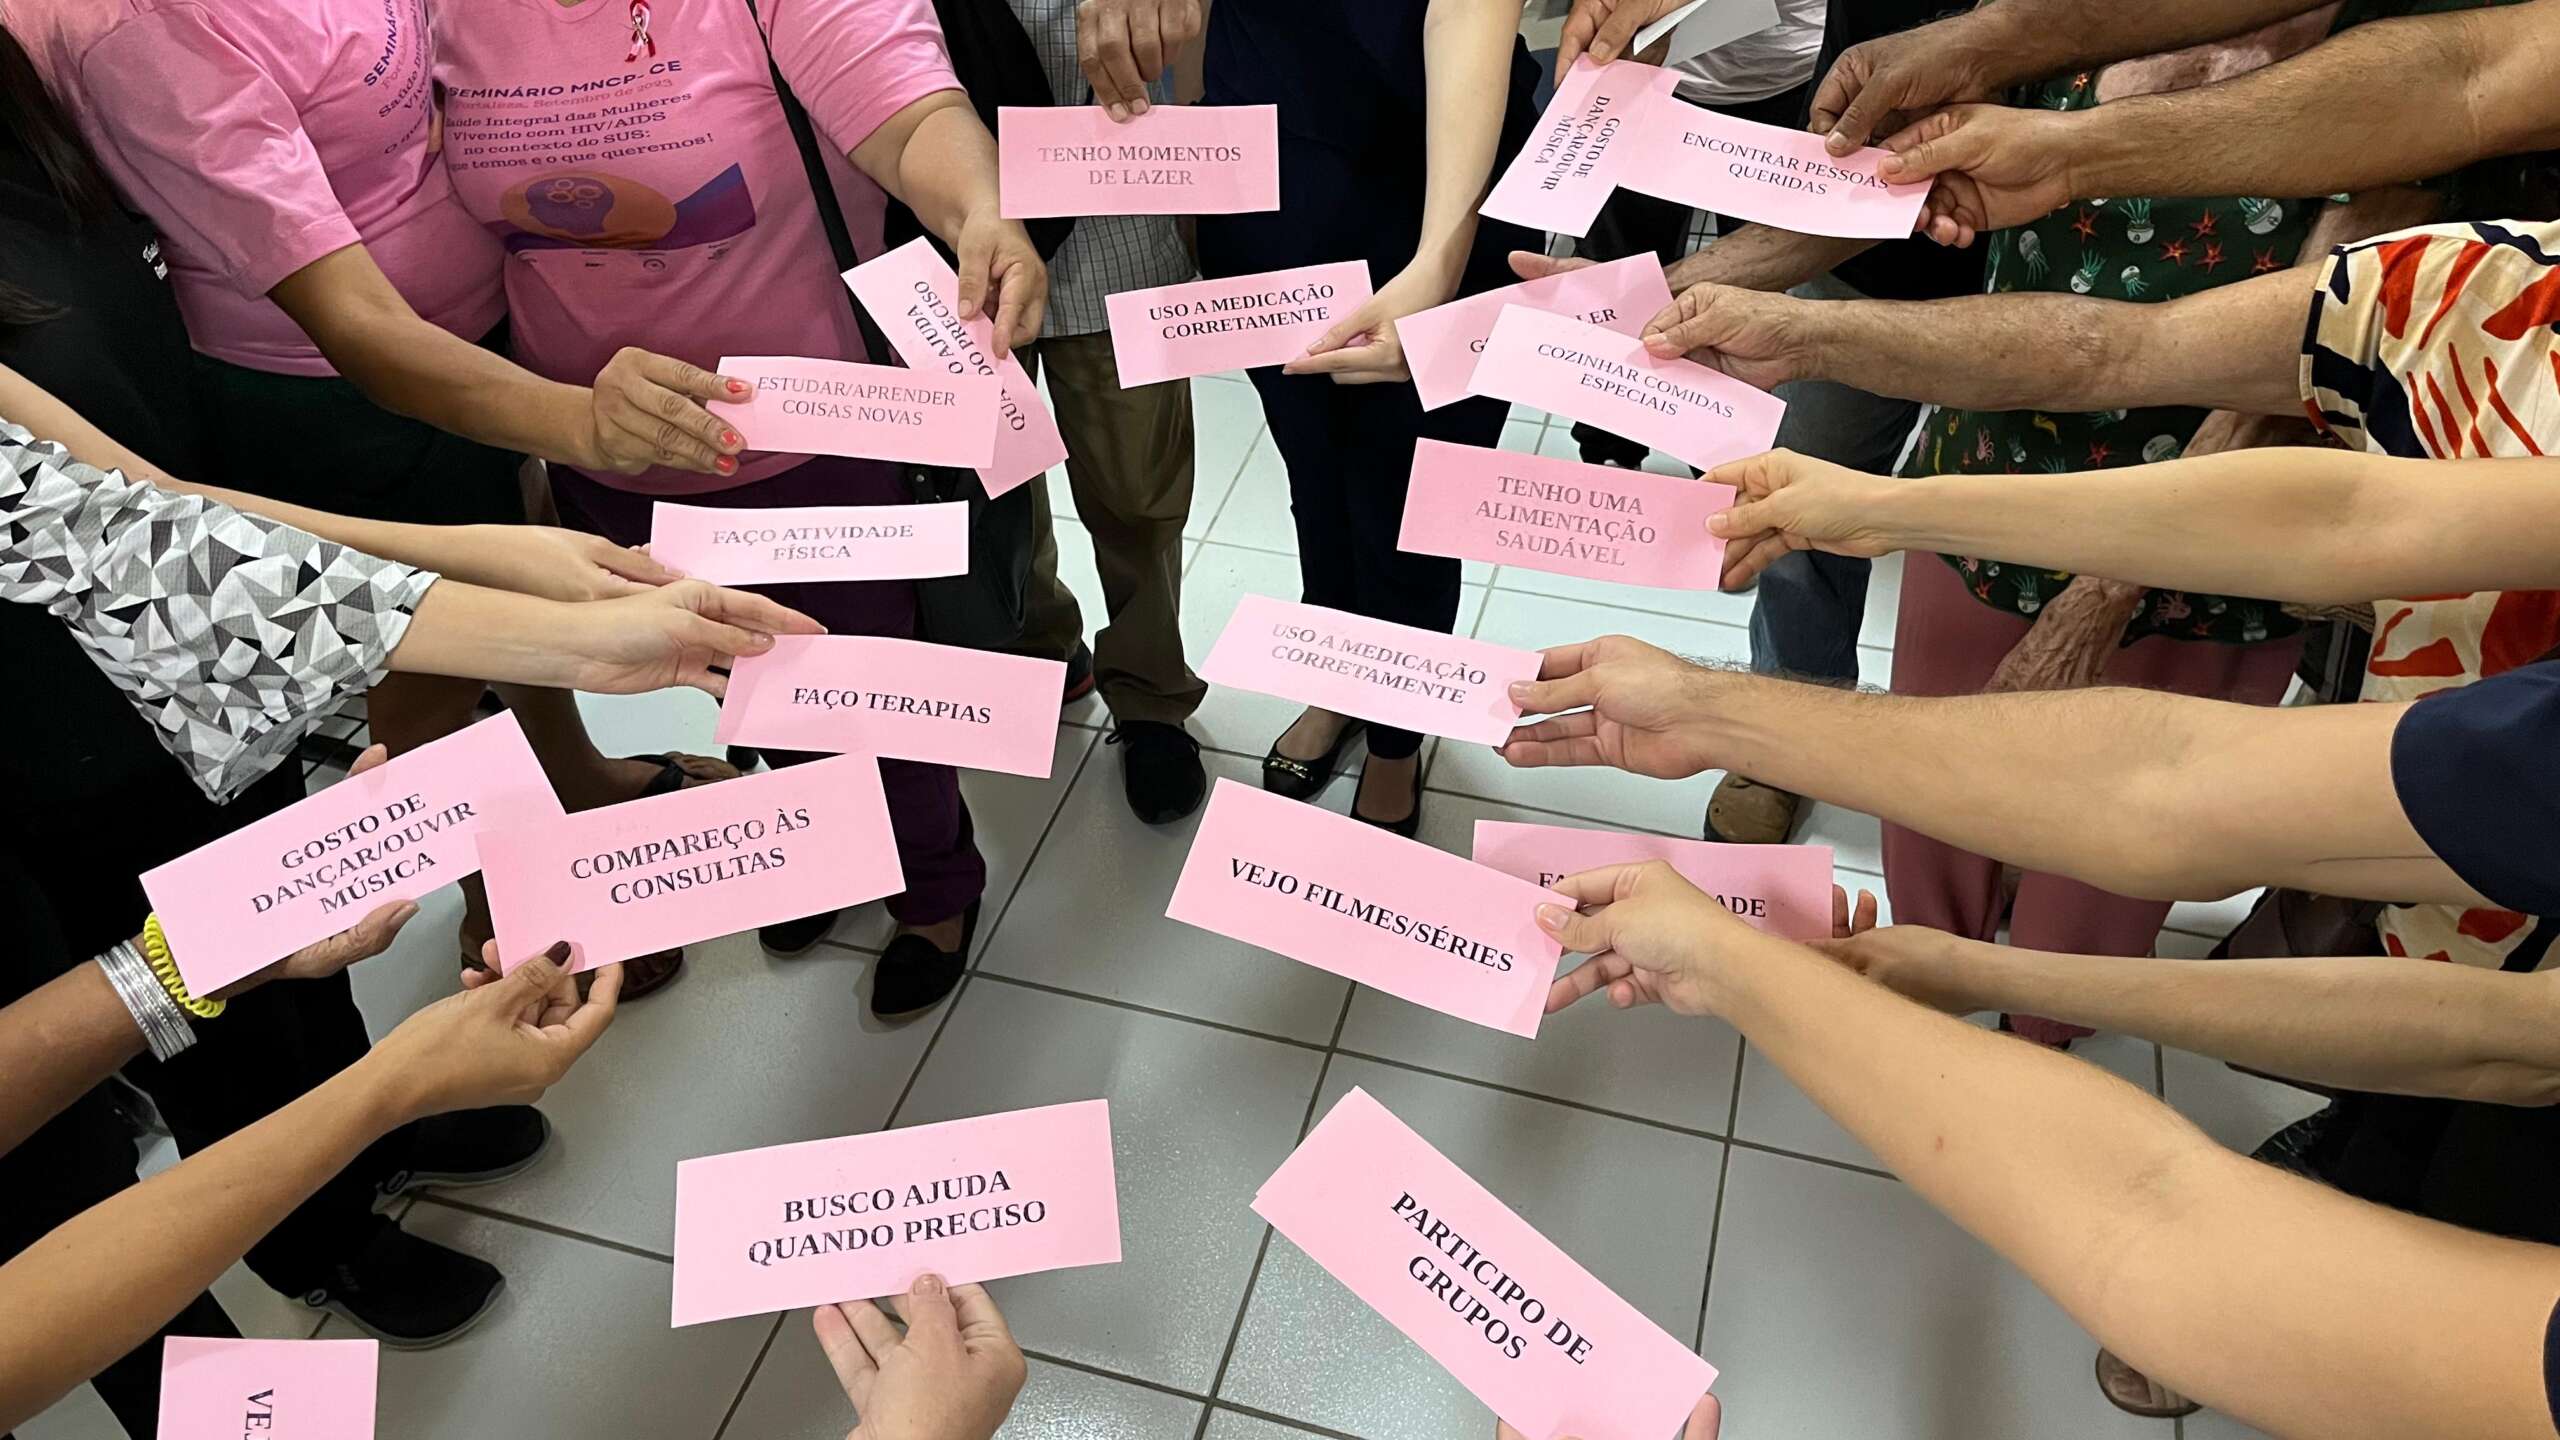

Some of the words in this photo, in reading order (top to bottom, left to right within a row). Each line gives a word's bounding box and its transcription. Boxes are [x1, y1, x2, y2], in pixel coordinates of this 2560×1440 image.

[363, 0, 397, 86] SEMINÁRI
[449, 86, 564, 98] SEMINÁRIO
[649, 60, 682, 75] CE
[614, 87, 633, 97] de
[638, 79, 673, 92] 2023
[453, 130, 521, 141] Vivendo
[526, 128, 565, 138] com
[571, 111, 667, 135] HIV/AIDS
[486, 114, 560, 127] Integral
[565, 112, 597, 122] das
[601, 92, 692, 118] Mulheres
[464, 146, 484, 155] no
[488, 141, 572, 154] contexto
[577, 137, 599, 147] do
[603, 129, 651, 144] SUS:
[472, 158, 528, 169] temos
[531, 157, 542, 165] e
[546, 156, 557, 164] o
[562, 151, 597, 164] que
[601, 132, 715, 161] queremos!
[1038, 146, 1112, 162] TENHO
[1118, 146, 1242, 162] MOMENTOS
[1534, 115, 1576, 164] MÚSICA
[1540, 95, 1610, 190] DANÇAR/OUVIR
[1590, 118, 1620, 161] GOSTO
[1682, 131, 1800, 170] ENCONTRAR
[1804, 161, 1889, 190] PESSOAS
[1089, 169, 1117, 185] DE
[1123, 169, 1195, 185] LAZER
[1572, 161, 1595, 178] DE
[1728, 162, 1828, 195] QUERIDAS
[914, 280, 975, 350] PRECISO
[1149, 303, 1188, 321] USO
[1194, 301, 1207, 315] A
[1211, 283, 1334, 312] MEDICAÇÃO
[1162, 306, 1330, 340] CORRETAMENTE
[906, 304, 954, 359] AJUDA
[757, 376, 955, 407] ESTUDAR/APRENDER
[1537, 343, 1638, 384] COZINHAR
[1644, 374, 1735, 419] COMIDAS
[1580, 373, 1679, 416] ESPECIAIS
[782, 399, 852, 419] COISAS
[858, 406, 923, 426] NOVAS
[1498, 476, 1581, 505] TENHO
[1589, 491, 1645, 515] UMA
[712, 529, 777, 546] FAÇO
[781, 525, 914, 541] ATIVIDADE
[1475, 500, 1656, 544] ALIMENTAÇÃO
[773, 544, 852, 561] FÍSICA
[1496, 530, 1625, 567] SAUDÁVEL
[1271, 645, 1466, 704] CORRETAMENTE
[1272, 623, 1316, 643] USO
[1321, 634, 1335, 649] A
[1338, 638, 1487, 686] MEDICAÇÃO
[792, 687, 858, 710] FAÇO
[865, 692, 991, 724] TERAPIAS
[281, 813, 379, 869] GOSTO
[384, 792, 426, 824] DE
[570, 819, 765, 880] COMPAREÇO
[775, 807, 811, 835] ÀS
[250, 801, 477, 914] DANÇAR/OUVIR
[610, 847, 786, 904] CONSULTAS
[319, 851, 436, 915] MÚSICA
[1230, 858, 1298, 896] VEJO
[1303, 883, 1514, 973] FILMES/SÉRIES
[783, 1188, 895, 1223] BUSCO
[903, 1170, 1011, 1209] AJUDA
[748, 1225, 894, 1266] QUANDO
[904, 1200, 1046, 1244] PRECISO
[1391, 1191, 1545, 1325] PARTICIPO
[1544, 1317, 1594, 1365] DE
[1408, 1255, 1528, 1360] GRUPOS
